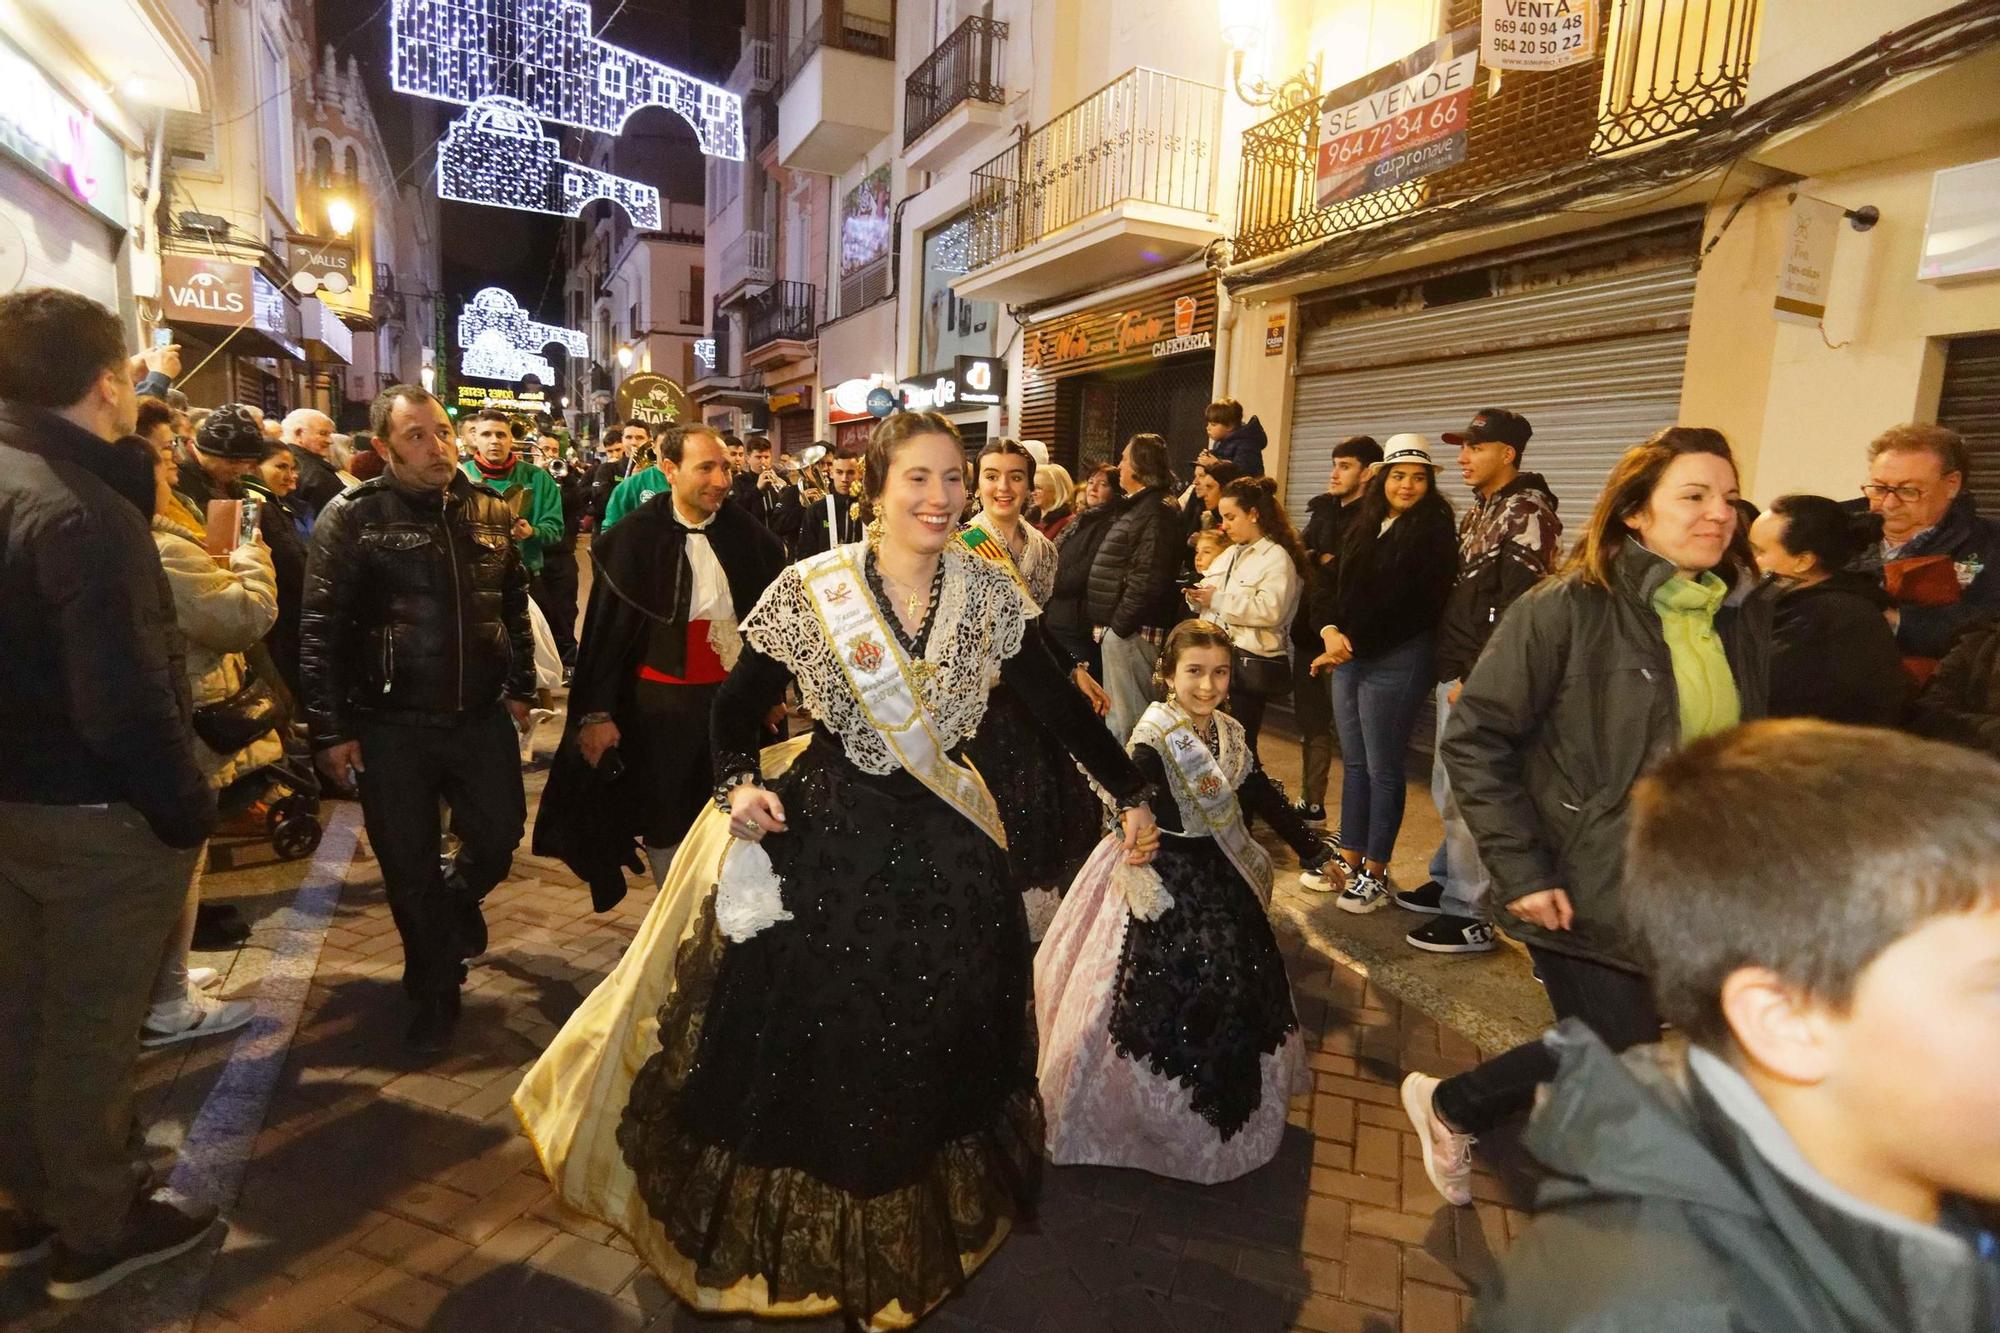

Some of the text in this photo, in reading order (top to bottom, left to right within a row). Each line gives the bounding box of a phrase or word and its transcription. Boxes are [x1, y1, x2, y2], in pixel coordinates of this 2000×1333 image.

[1506, 0, 1570, 18] VENTA
[1494, 15, 1582, 35] 669 40 94 48
[1493, 34, 1581, 54] 964 20 50 22
[1329, 61, 1463, 136] SE VENDE
[1328, 132, 1364, 166] 964
[1368, 124, 1392, 153] 72
[1395, 111, 1424, 141] 34
[1430, 97, 1458, 129] 66
[1374, 137, 1453, 178] caspronave
[310, 252, 347, 269] VALLS
[168, 285, 244, 313] VALLS
[1152, 332, 1212, 357] CAFETERIA
